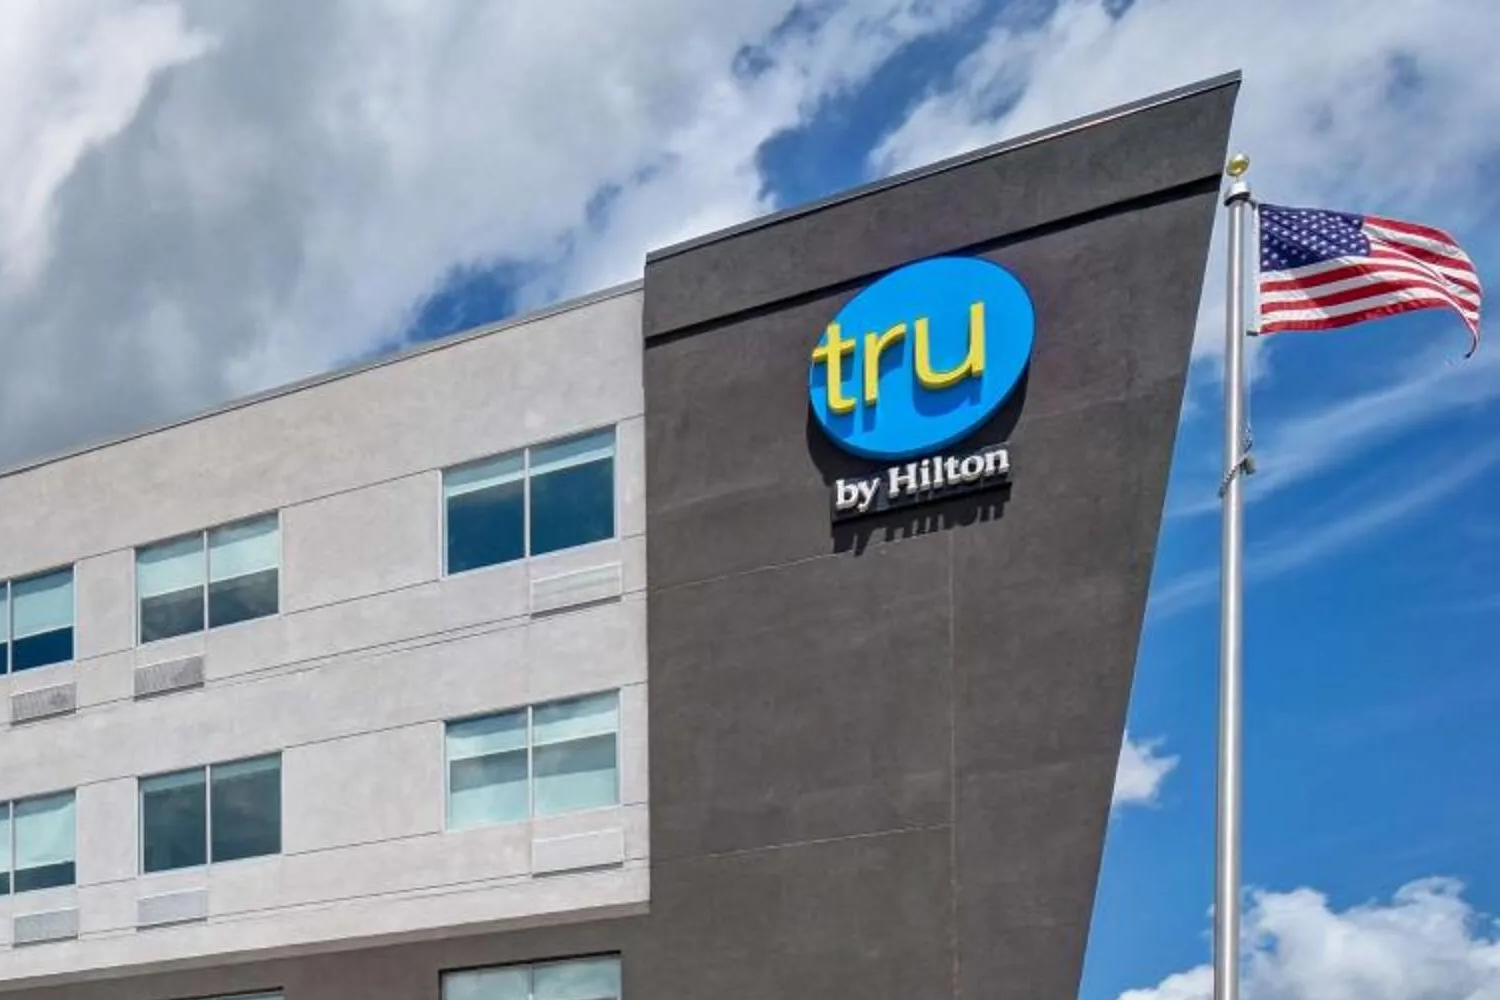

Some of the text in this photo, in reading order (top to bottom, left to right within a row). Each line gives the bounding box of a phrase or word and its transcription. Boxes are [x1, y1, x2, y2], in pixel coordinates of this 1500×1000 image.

[811, 301, 986, 413] tru
[835, 449, 1011, 512] by Hilton
